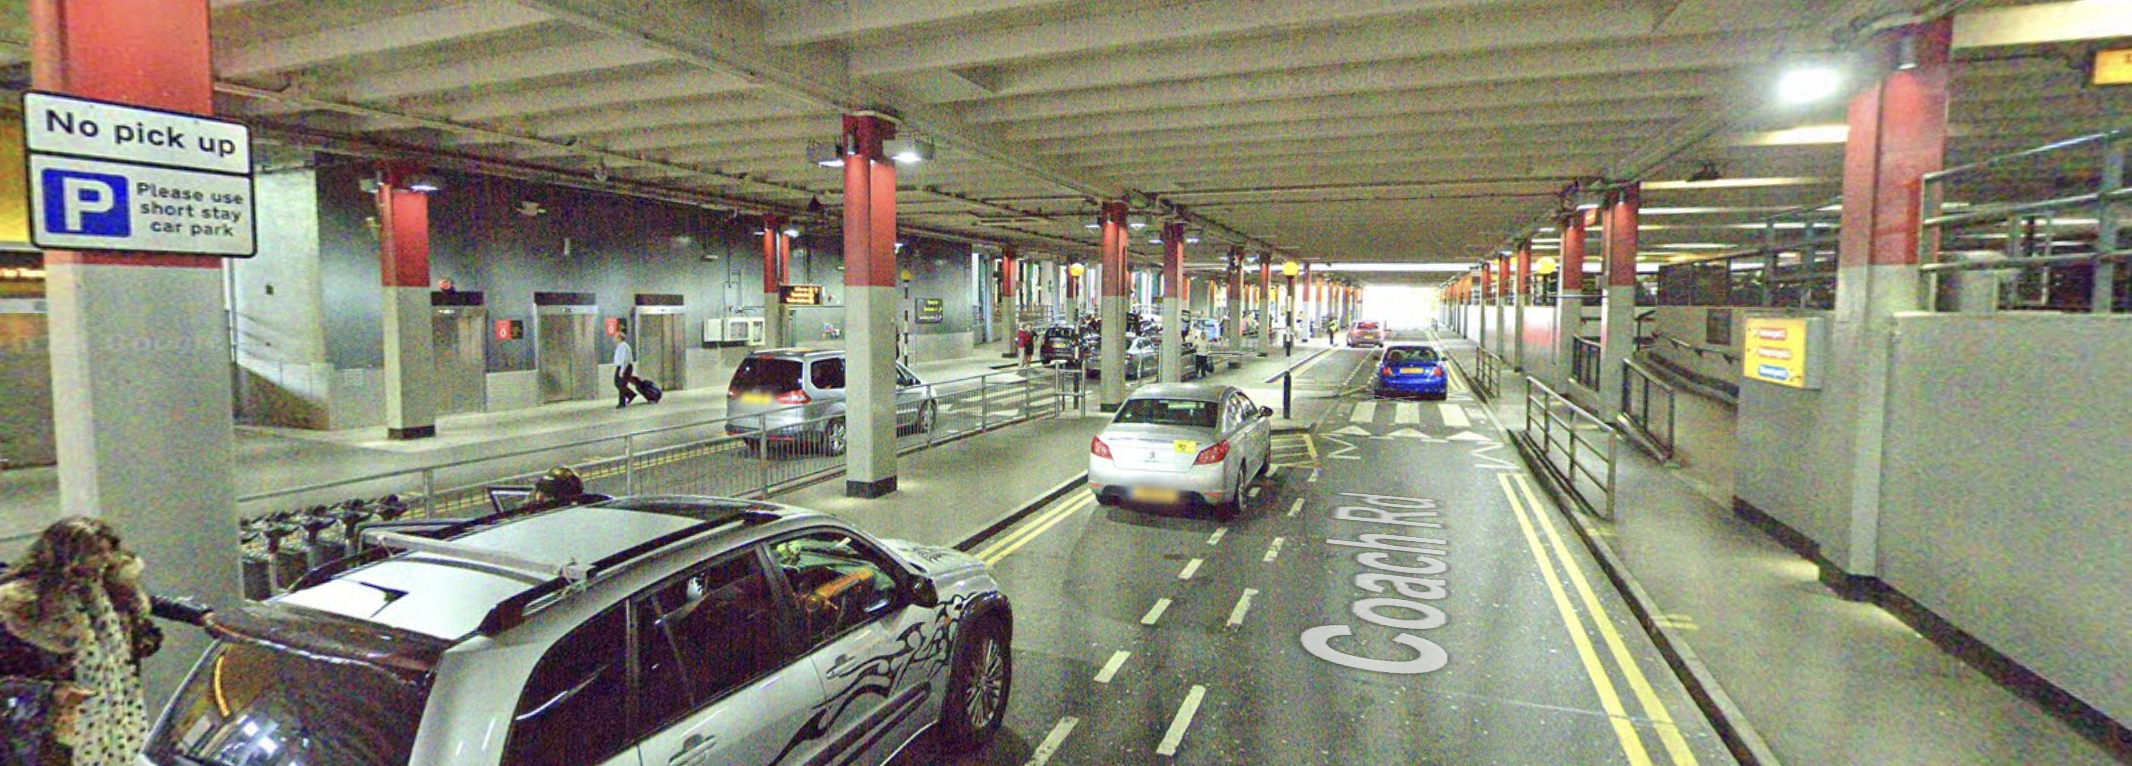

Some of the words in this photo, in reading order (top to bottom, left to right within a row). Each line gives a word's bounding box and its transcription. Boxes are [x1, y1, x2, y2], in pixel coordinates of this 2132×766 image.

[46, 109, 98, 137] No
[114, 122, 186, 148] pick
[199, 135, 235, 157] up
[62, 176, 114, 231] P
[137, 182, 204, 202] Please
[211, 191, 243, 204] use
[140, 201, 195, 217] short
[201, 206, 241, 222] stay
[150, 221, 182, 232] car
[190, 225, 234, 236] park
